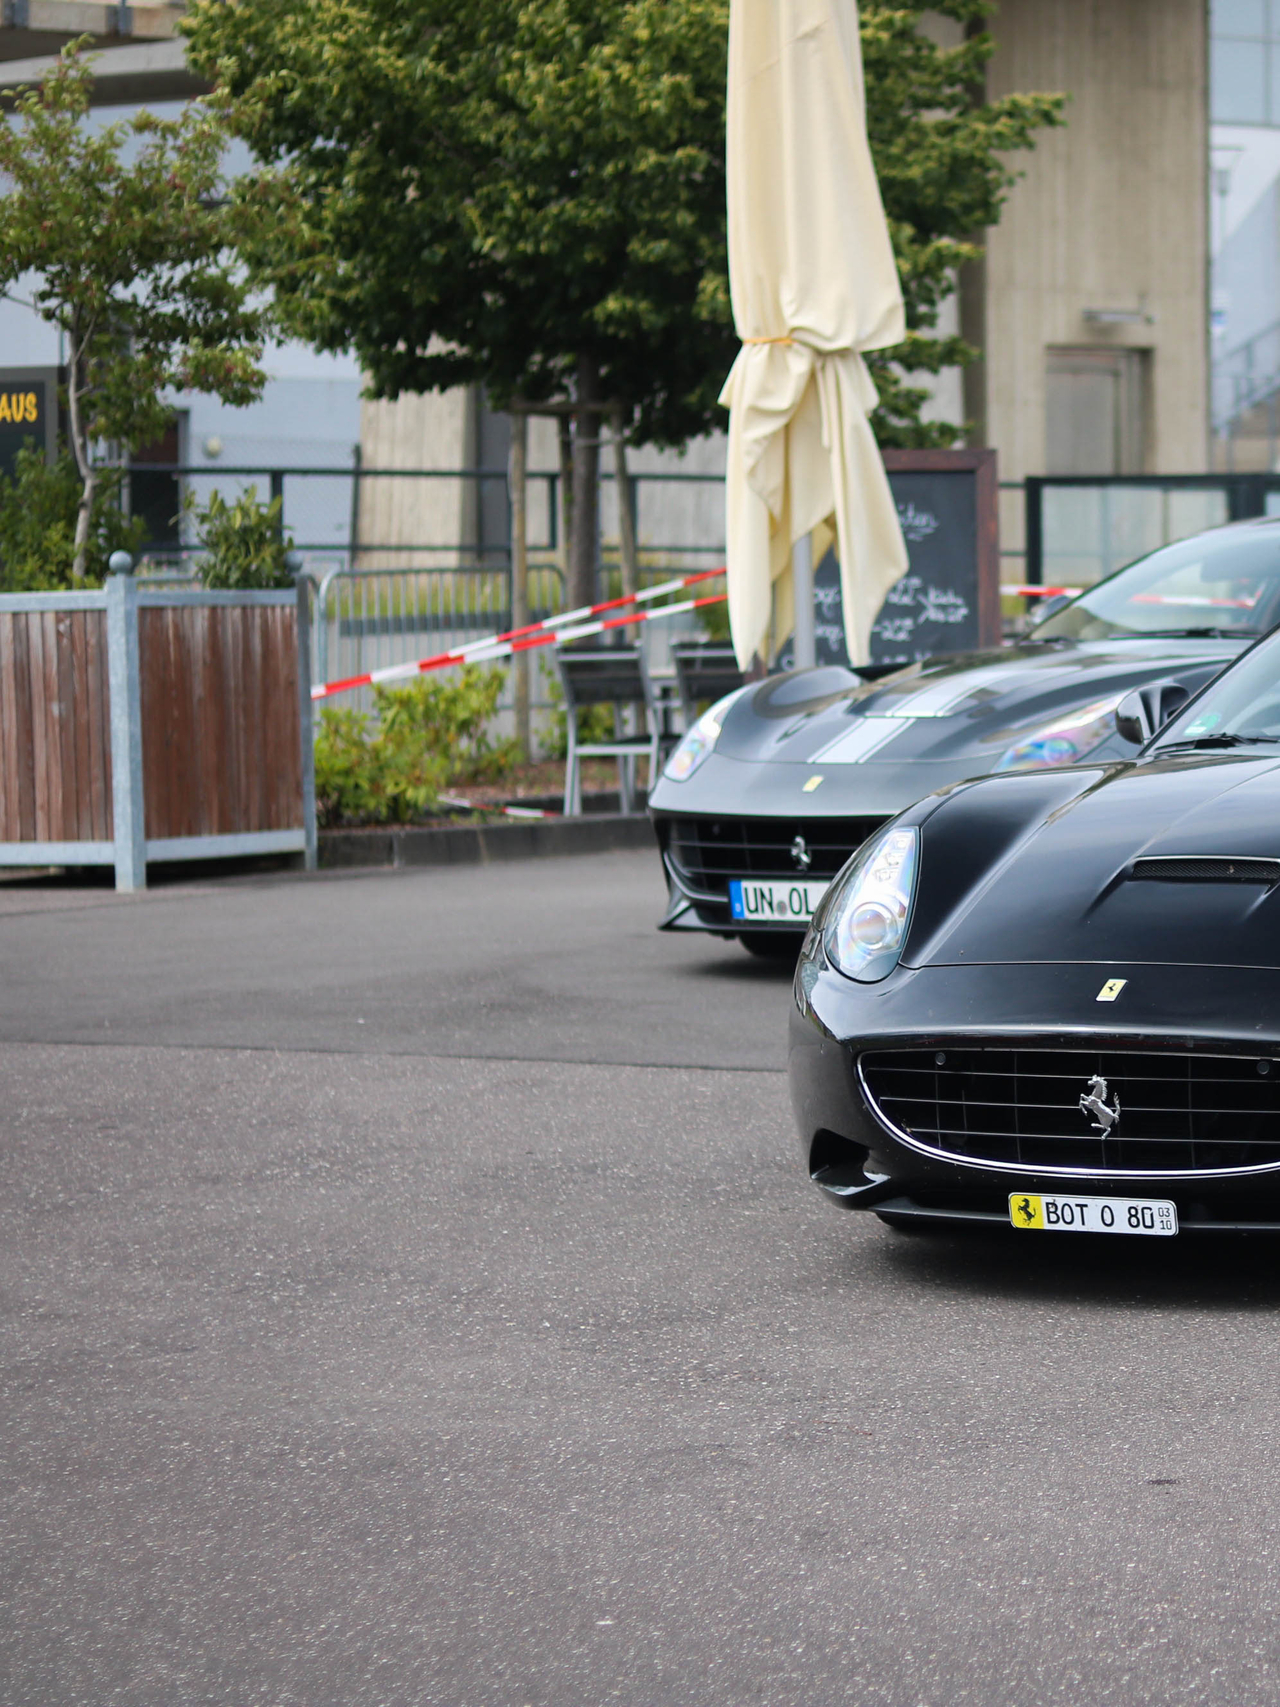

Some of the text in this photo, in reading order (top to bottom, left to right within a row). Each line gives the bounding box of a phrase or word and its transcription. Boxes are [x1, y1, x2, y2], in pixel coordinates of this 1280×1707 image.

[744, 887, 816, 916] UN OL
[1045, 1202, 1088, 1226] BOT
[1127, 1206, 1155, 1229] 80
[1158, 1207, 1171, 1218] 03
[1160, 1220, 1172, 1230] 10
